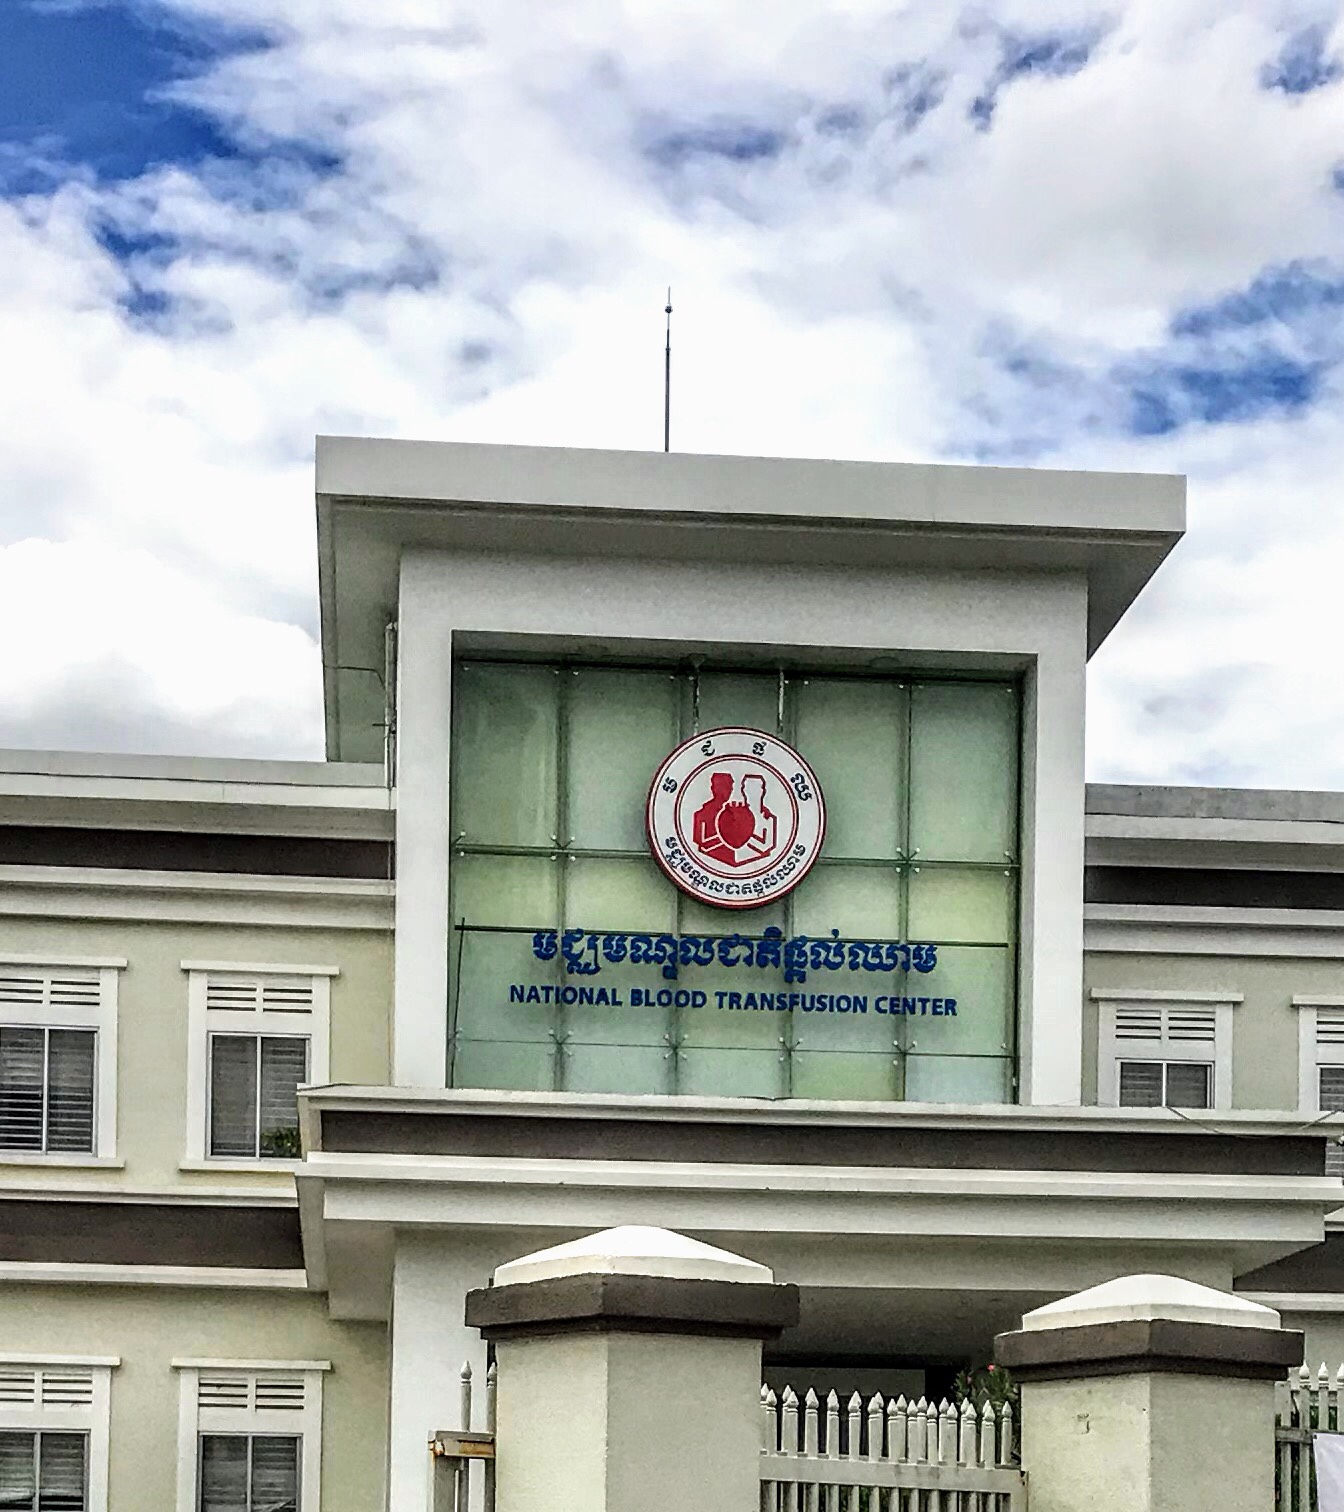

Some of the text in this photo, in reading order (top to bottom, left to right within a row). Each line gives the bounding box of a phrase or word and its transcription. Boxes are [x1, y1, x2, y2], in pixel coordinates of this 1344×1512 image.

[510, 984, 958, 1017] NATIONAL BLOOD TRANSFUSION CENTER
